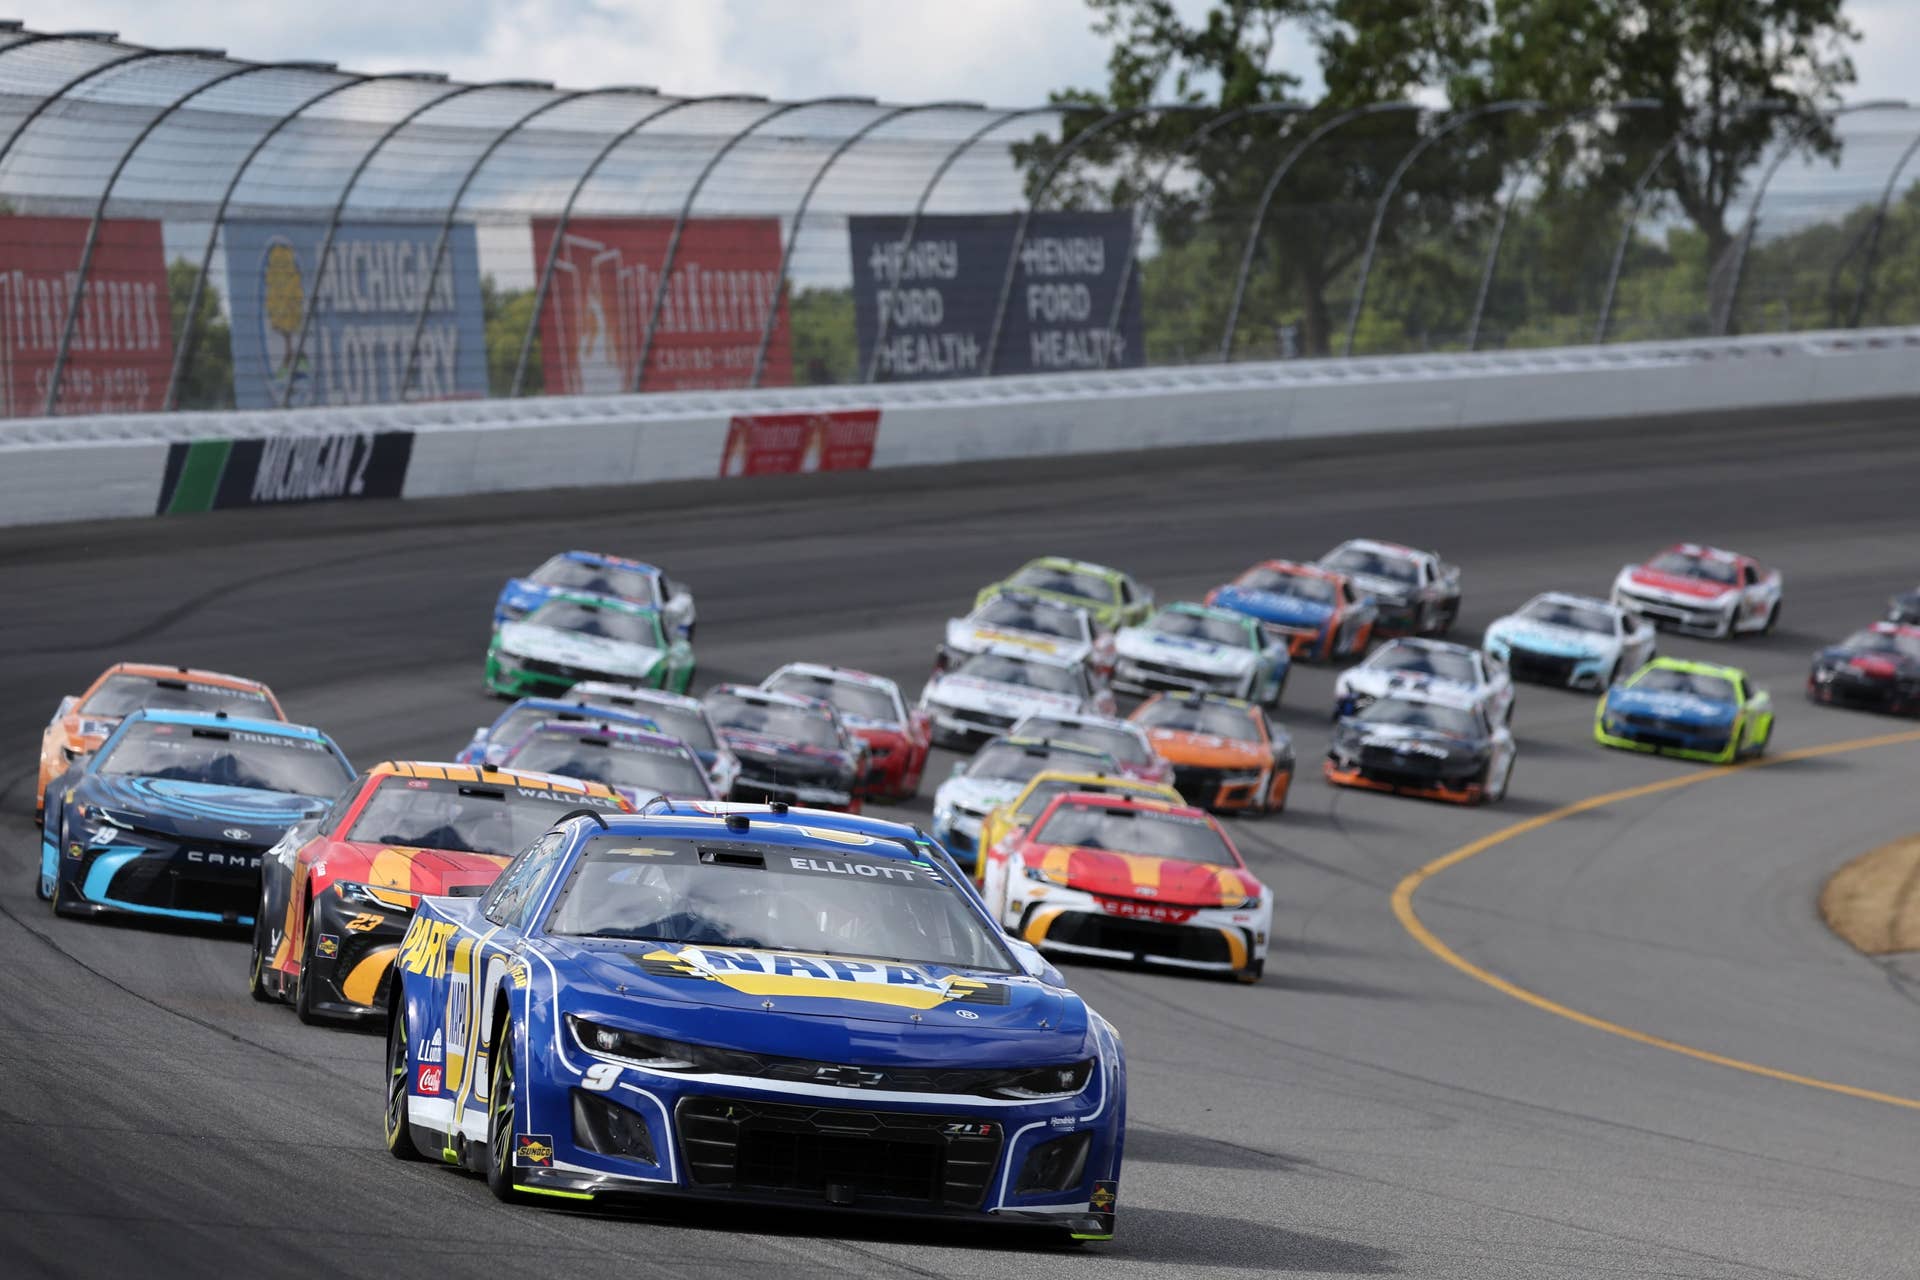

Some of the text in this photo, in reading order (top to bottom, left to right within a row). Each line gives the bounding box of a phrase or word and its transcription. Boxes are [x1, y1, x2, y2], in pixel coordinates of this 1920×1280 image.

[869, 240, 958, 280] HENRY
[1021, 237, 1105, 276] HENRY
[877, 287, 944, 326] FORD
[1027, 284, 1091, 321] FORD
[881, 333, 981, 372] HEALTH
[1030, 329, 1127, 367] HEALTH
[250, 433, 356, 501] MICHIGAN
[234, 732, 296, 748] TRUEX
[517, 788, 618, 809] WALLACE
[187, 850, 264, 869] CAMR
[789, 857, 916, 881] ELLIOTT
[345, 912, 385, 932] 23
[704, 949, 943, 990] NAPA
[581, 1063, 625, 1092] 9
[518, 1147, 552, 1157] SUNOCO
